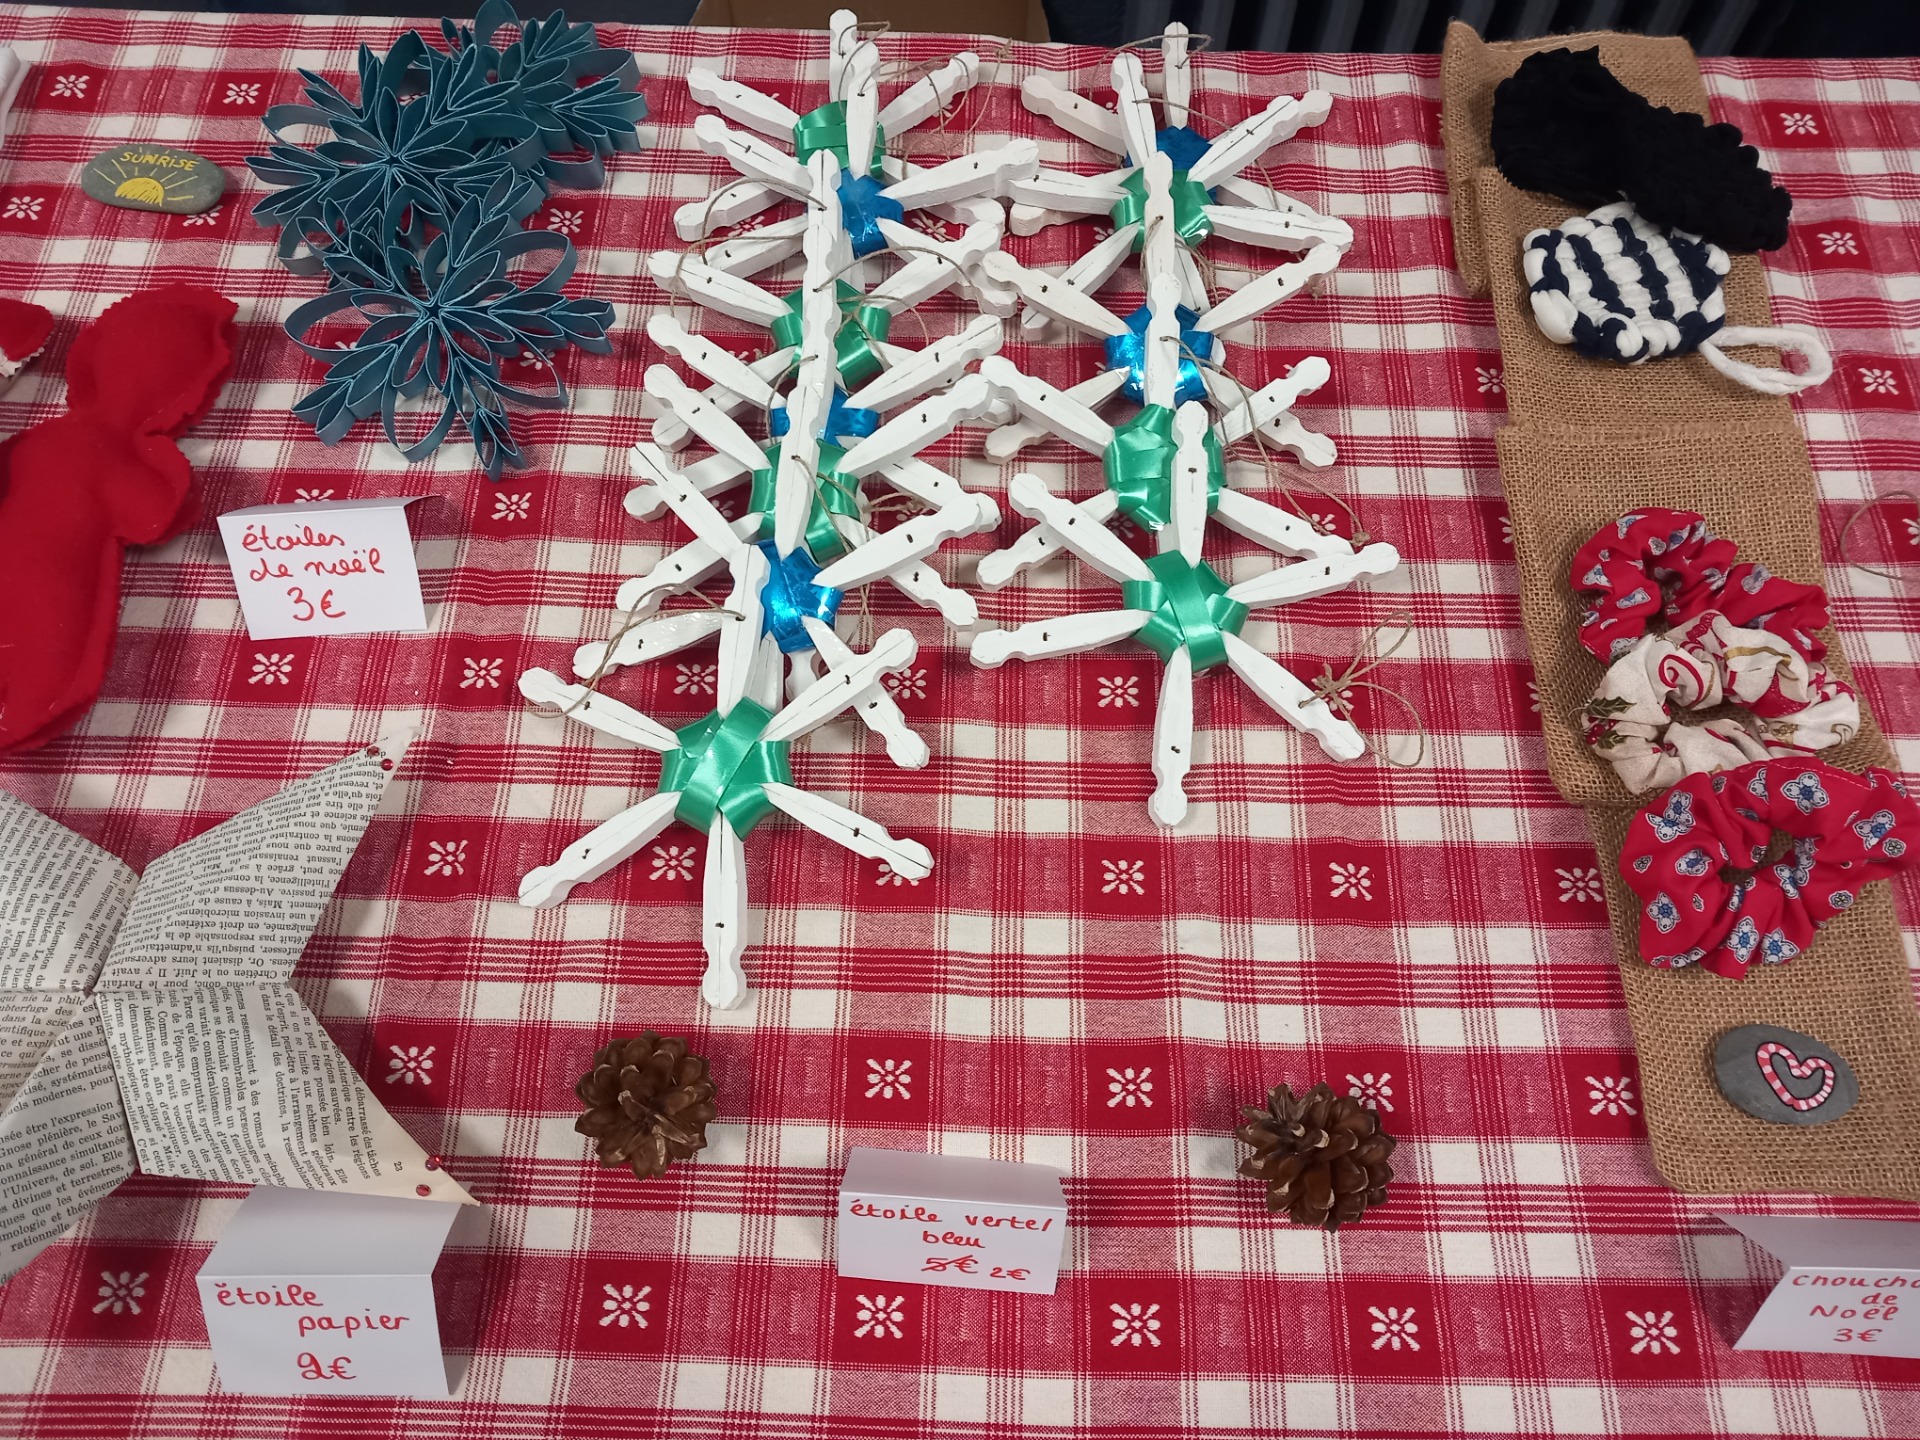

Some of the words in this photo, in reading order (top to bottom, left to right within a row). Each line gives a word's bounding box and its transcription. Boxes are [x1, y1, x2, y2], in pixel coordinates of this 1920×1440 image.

[242, 524, 345, 552] étoiles
[250, 558, 294, 582] de
[287, 587, 346, 621] 3€
[332, 789, 363, 800] qu'elle
[323, 811, 357, 822] science
[268, 831, 319, 843] contrainte
[247, 852, 298, 862] renaissant
[315, 843, 341, 853] parce
[266, 863, 294, 874] grâce
[299, 864, 323, 875] peut,
[306, 855, 342, 866] l'assaut
[4, 857, 29, 897] originelle
[32, 860, 56, 890] matière,
[253, 874, 263, 885] la
[266, 874, 330, 888] l'intelligence,
[197, 897, 210, 906] de
[214, 897, 242, 905] cause
[223, 886, 274, 897] Au-dessus
[277, 887, 315, 899] passive.
[24, 892, 40, 913] dans
[255, 897, 283, 909] Mais,
[218, 921, 244, 931] droit
[242, 910, 285, 921] invasion
[288, 912, 306, 920] une
[24, 907, 46, 948] éléments
[164, 931, 174, 941] la
[178, 932, 190, 941] de
[194, 931, 255, 942] responsable
[258, 933, 275, 942] pas
[5, 929, 26, 961] temps,
[38, 919, 66, 970] rédemption
[73, 932, 89, 950] dont
[82, 922, 108, 959] appartient
[129, 943, 201, 954] n'admettaient
[206, 942, 255, 954] puisqu'ils
[62, 952, 77, 974] nous
[144, 966, 153, 975] y
[171, 956, 198, 966] leurs
[202, 956, 243, 966] disaient
[247, 956, 264, 967] Or,
[11, 967, 24, 991] bien
[111, 967, 140, 977] avait
[158, 968, 167, 977] Il
[162, 976, 188, 987] pour
[172, 968, 197, 978] Juif.
[201, 968, 211, 978] le
[233, 969, 277, 979] Chrétien
[99, 979, 143, 989] Parfait.
[148, 980, 157, 989] le
[1, 1013, 26, 1022] dans
[113, 997, 125, 1027] forme
[182, 995, 194, 1019] Parce
[128, 1002, 144, 1055] demandait
[157, 1010, 169, 1046] Comme
[197, 1006, 211, 1037] variait
[141, 1005, 159, 1070] indéfiniment,
[184, 1021, 199, 1053] qu'elle
[239, 1013, 257, 1074] ressemblaient
[267, 1024, 280, 1047] détail
[162, 1050, 173, 1068] elle
[171, 1028, 186, 1072] l'époque,
[215, 1028, 229, 1072] déroulait
[272, 1050, 283, 1066] des
[117, 1031, 142, 1101] mythologique,
[228, 1027, 247, 1101] d'innombrables
[297, 1049, 310, 1075] limite
[310, 1053, 321, 1071] être
[89, 1073, 116, 1090] pour
[138, 1067, 150, 1088] être
[152, 1076, 165, 1095] afin
[165, 1073, 178, 1100] avait
[179, 1078, 191, 1096] elle
[189, 1055, 207, 1114] empruntait
[202, 1040, 223, 1127] considérablement
[221, 1076, 232, 1111] comme
[250, 1089, 261, 1106] des
[273, 1070, 288, 1118] doctrines,
[279, 1034, 297, 1073] peut-être
[289, 1087, 309, 1157] l'arrangement
[302, 1080, 312, 1098] aux
[312, 1076, 329, 1112] poussée
[321, 1053, 336, 1084] régions
[329, 1086, 343, 1125] sauvées.
[110, 1043, 123, 1069] voire
[136, 1138, 151, 1163] C'est
[143, 1091, 165, 1132] expliqué
[25, 1121, 48, 1135] être
[50, 1100, 114, 1128] l'expression
[136, 1104, 154, 1133] même
[171, 1104, 190, 1141] vocation
[183, 1102, 203, 1142] brassait
[225, 1115, 234, 1129] un
[280, 1121, 290, 1132] la
[305, 1103, 319, 1143] schèmes
[320, 1115, 331, 1136] bien
[345, 1105, 357, 1131] entre
[36, 1124, 83, 1147] plénière,
[86, 1118, 97, 1128] le
[156, 1101, 183, 1157] d'expliquer,
[236, 1105, 261, 1163] personnages
[252, 1111, 266, 1148] romans
[354, 1086, 371, 1134] débarrassé
[366, 1149, 383, 1176] tâches
[16, 1143, 58, 1167] général
[61, 1139, 74, 1150] de
[78, 1130, 102, 1145] ceux
[69, 1134, 125, 1161] simultanée
[216, 1130, 233, 1155] d'une
[349, 1134, 360, 1146] les
[152, 1149, 166, 1174] cette
[161, 1144, 178, 1171] Mais,
[199, 1147, 212, 1163] des
[229, 1133, 255, 1174] feuilleton
[324, 1142, 336, 1163] loin.
[2, 1173, 58, 1199] l'Univers,
[62, 1166, 75, 1177] de
[78, 1157, 98, 1171] soi.
[101, 1148, 123, 1163] Elle
[229, 1158, 246, 1179] école
[309, 1149, 338, 1186] généraux
[351, 1148, 371, 1179] régions
[393, 1160, 402, 1171] 23
[11, 1188, 52, 1209] divines
[55, 1181, 67, 1193] et
[69, 1162, 124, 1189] terrestres,
[31, 1203, 52, 1217] que
[56, 1194, 72, 1207] les
[850, 1199, 943, 1222] étoile
[9, 1221, 70, 1252] rationnelle
[923, 1230, 986, 1248] bleu
[989, 1267, 1031, 1281] 2€
[1861, 1293, 1898, 1305] de
[298, 1308, 410, 1338] papier
[1833, 1328, 1883, 1343] 3€
